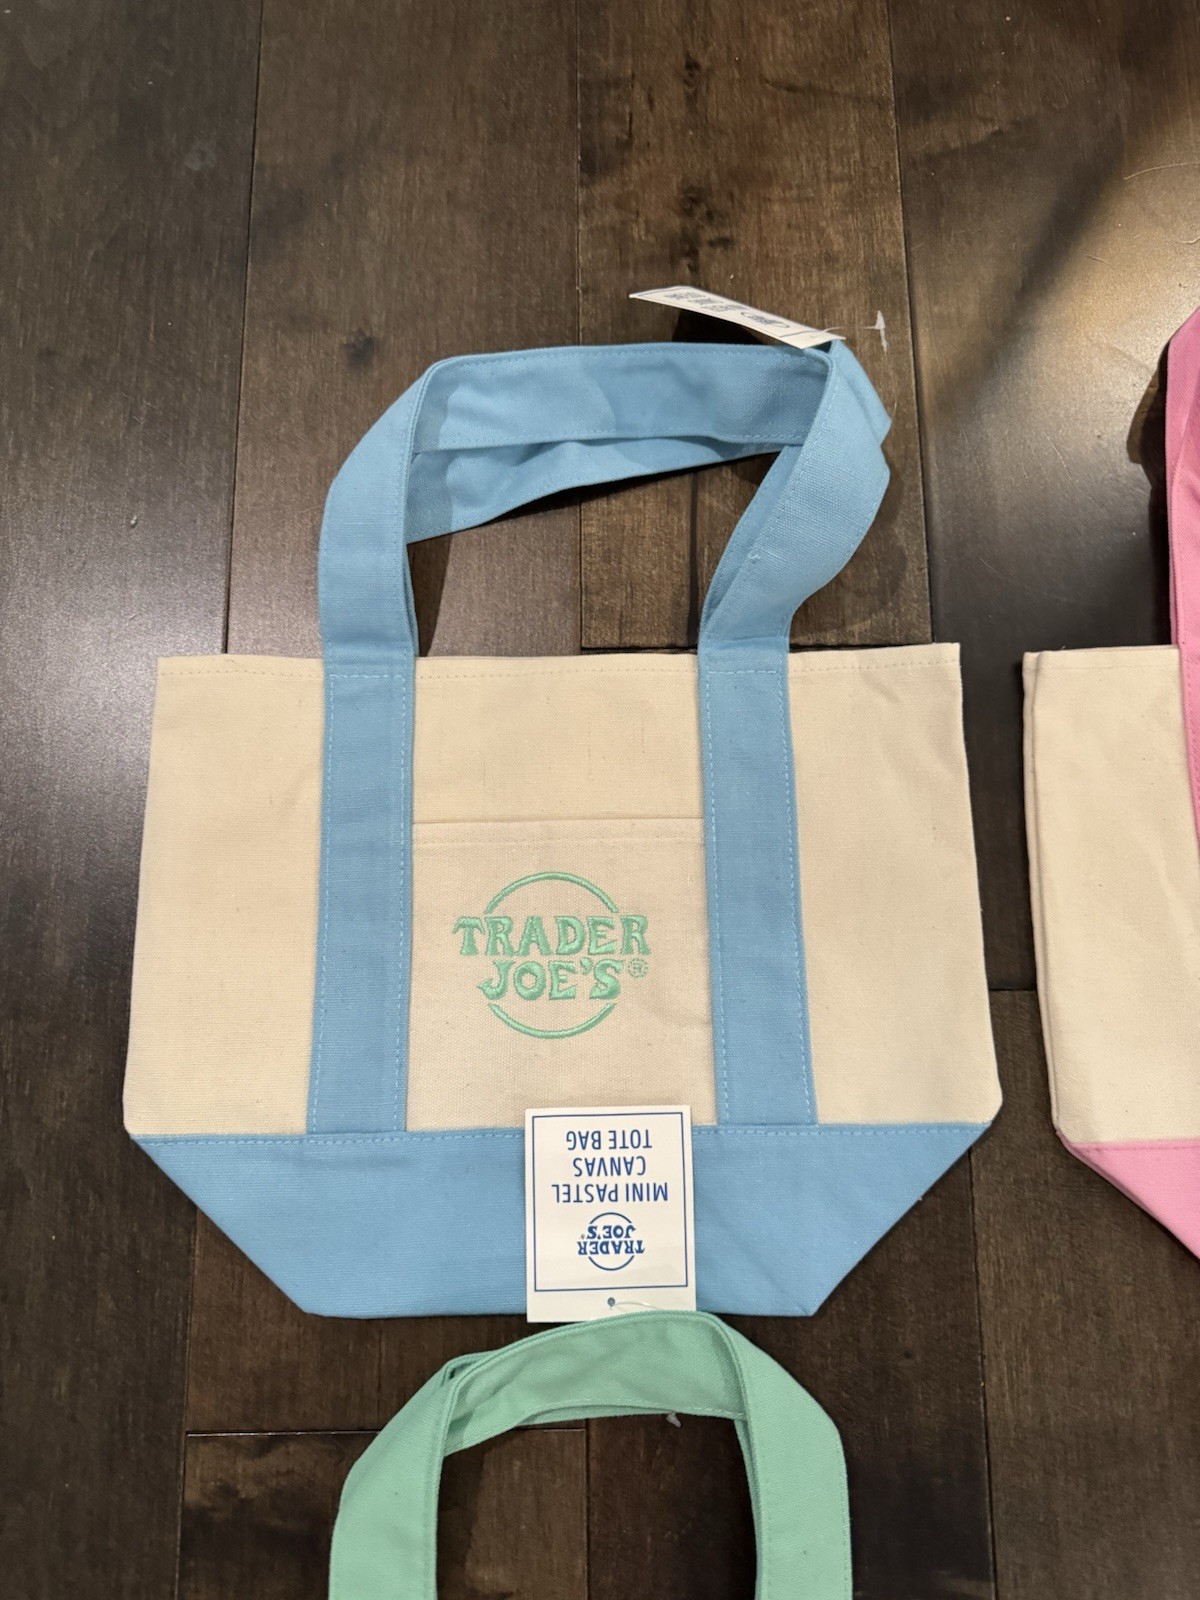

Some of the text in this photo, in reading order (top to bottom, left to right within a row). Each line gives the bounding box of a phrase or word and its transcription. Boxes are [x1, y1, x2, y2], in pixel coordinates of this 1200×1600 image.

[452, 914, 651, 956] TRADER
[565, 1129, 653, 1150] TOTE BAG
[572, 1155, 646, 1177] CANVAS
[551, 1182, 668, 1203] MINI PASTEL
[577, 1239, 645, 1256] TRADER
